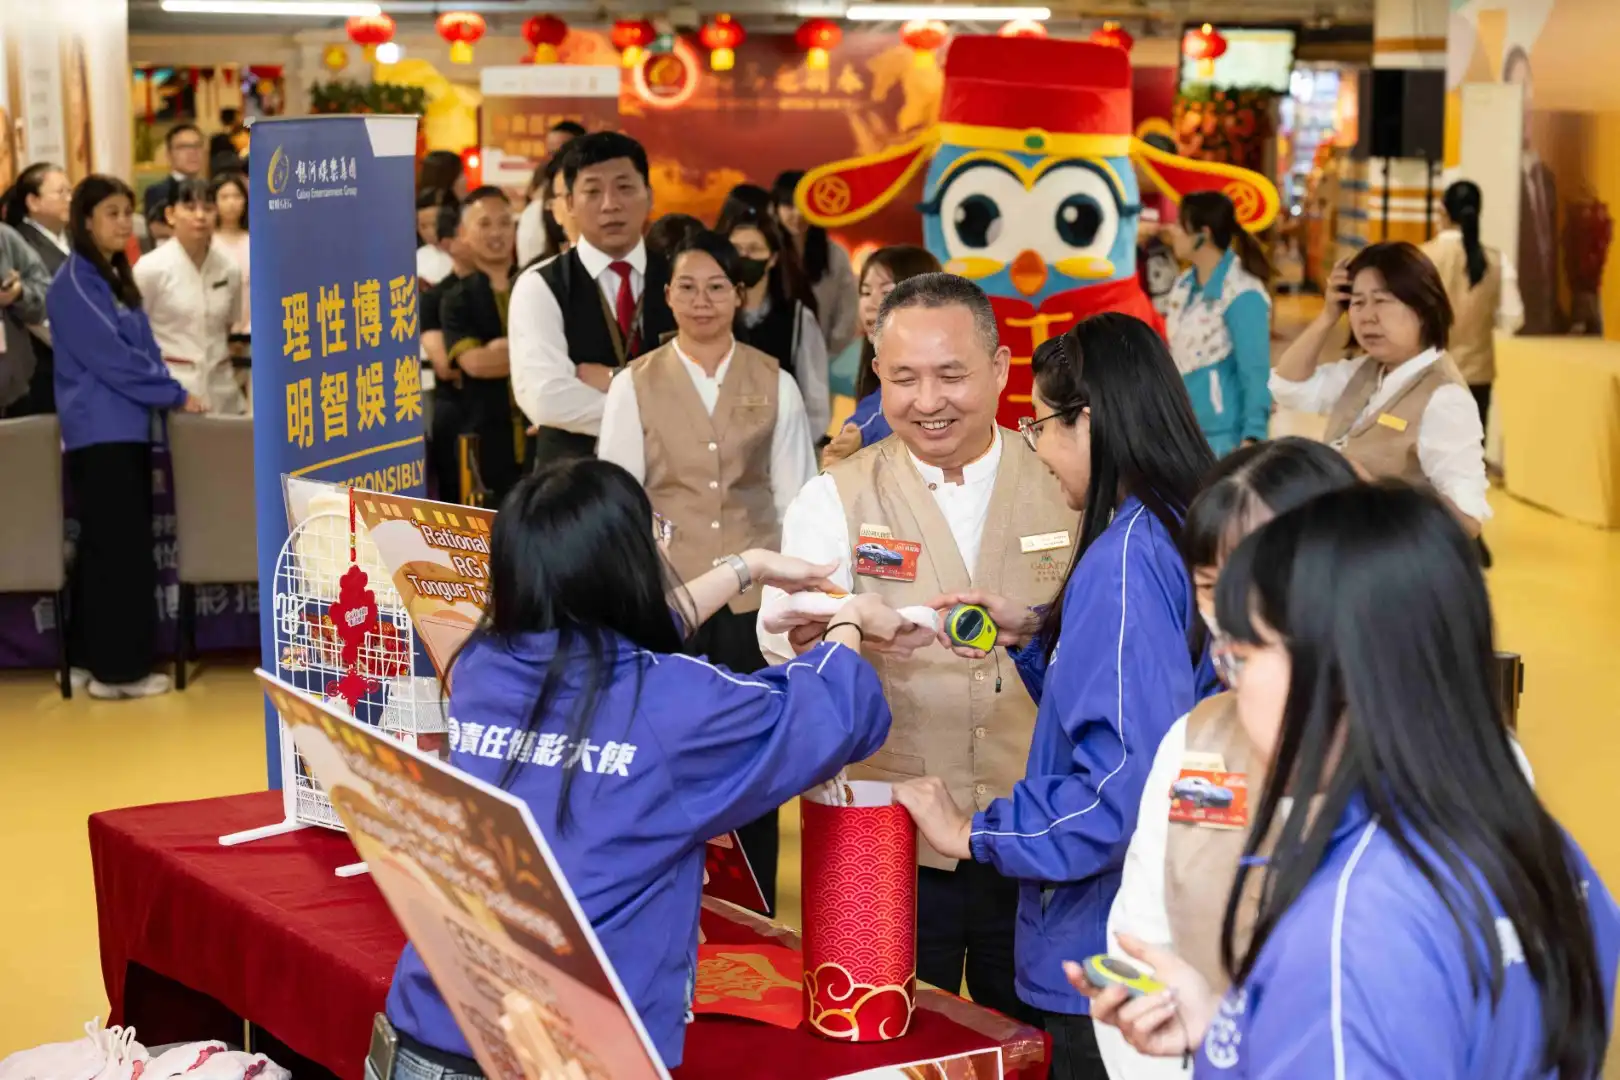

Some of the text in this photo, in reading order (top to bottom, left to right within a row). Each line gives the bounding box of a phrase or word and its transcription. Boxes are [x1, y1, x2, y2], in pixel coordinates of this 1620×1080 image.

[281, 274, 417, 362] 理性博彩
[286, 355, 422, 449] 明智娛樂
[407, 574, 467, 602] Tongue
[452, 556, 484, 578] RG
